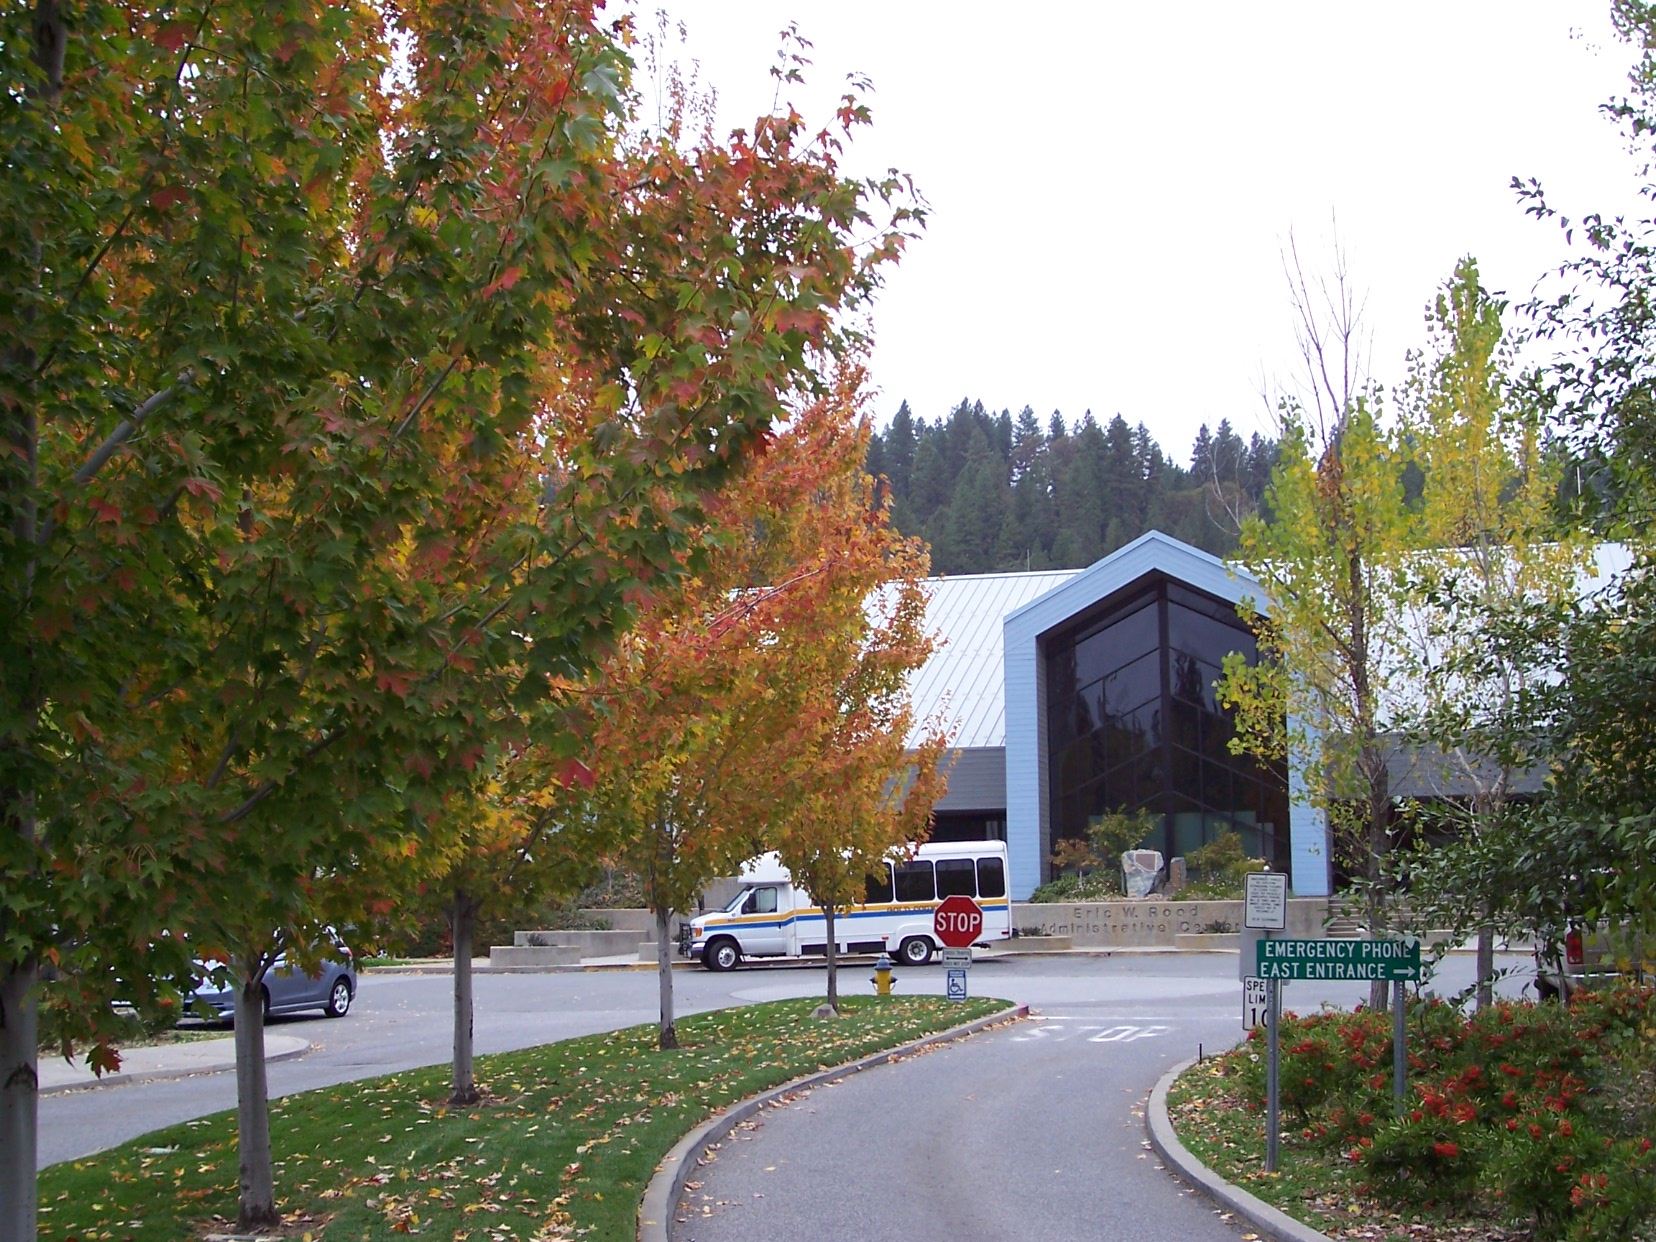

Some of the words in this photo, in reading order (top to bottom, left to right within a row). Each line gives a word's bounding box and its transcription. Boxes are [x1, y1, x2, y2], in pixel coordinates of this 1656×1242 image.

[1074, 907, 1112, 919] Eric
[1122, 906, 1138, 918] W.
[1148, 905, 1199, 917] Rood
[936, 911, 981, 933] STOP
[1040, 921, 1166, 934] Administrative
[1180, 921, 1239, 932] Ceer
[1265, 941, 1355, 958] EMERGENCY
[1362, 942, 1411, 958] PHONE
[1260, 962, 1300, 978] EAST
[1306, 963, 1386, 979] ENTRANCE
[1246, 980, 1265, 992] SPE
[1248, 993, 1266, 1004] LIM
[1010, 1025, 1175, 1042] STOP
